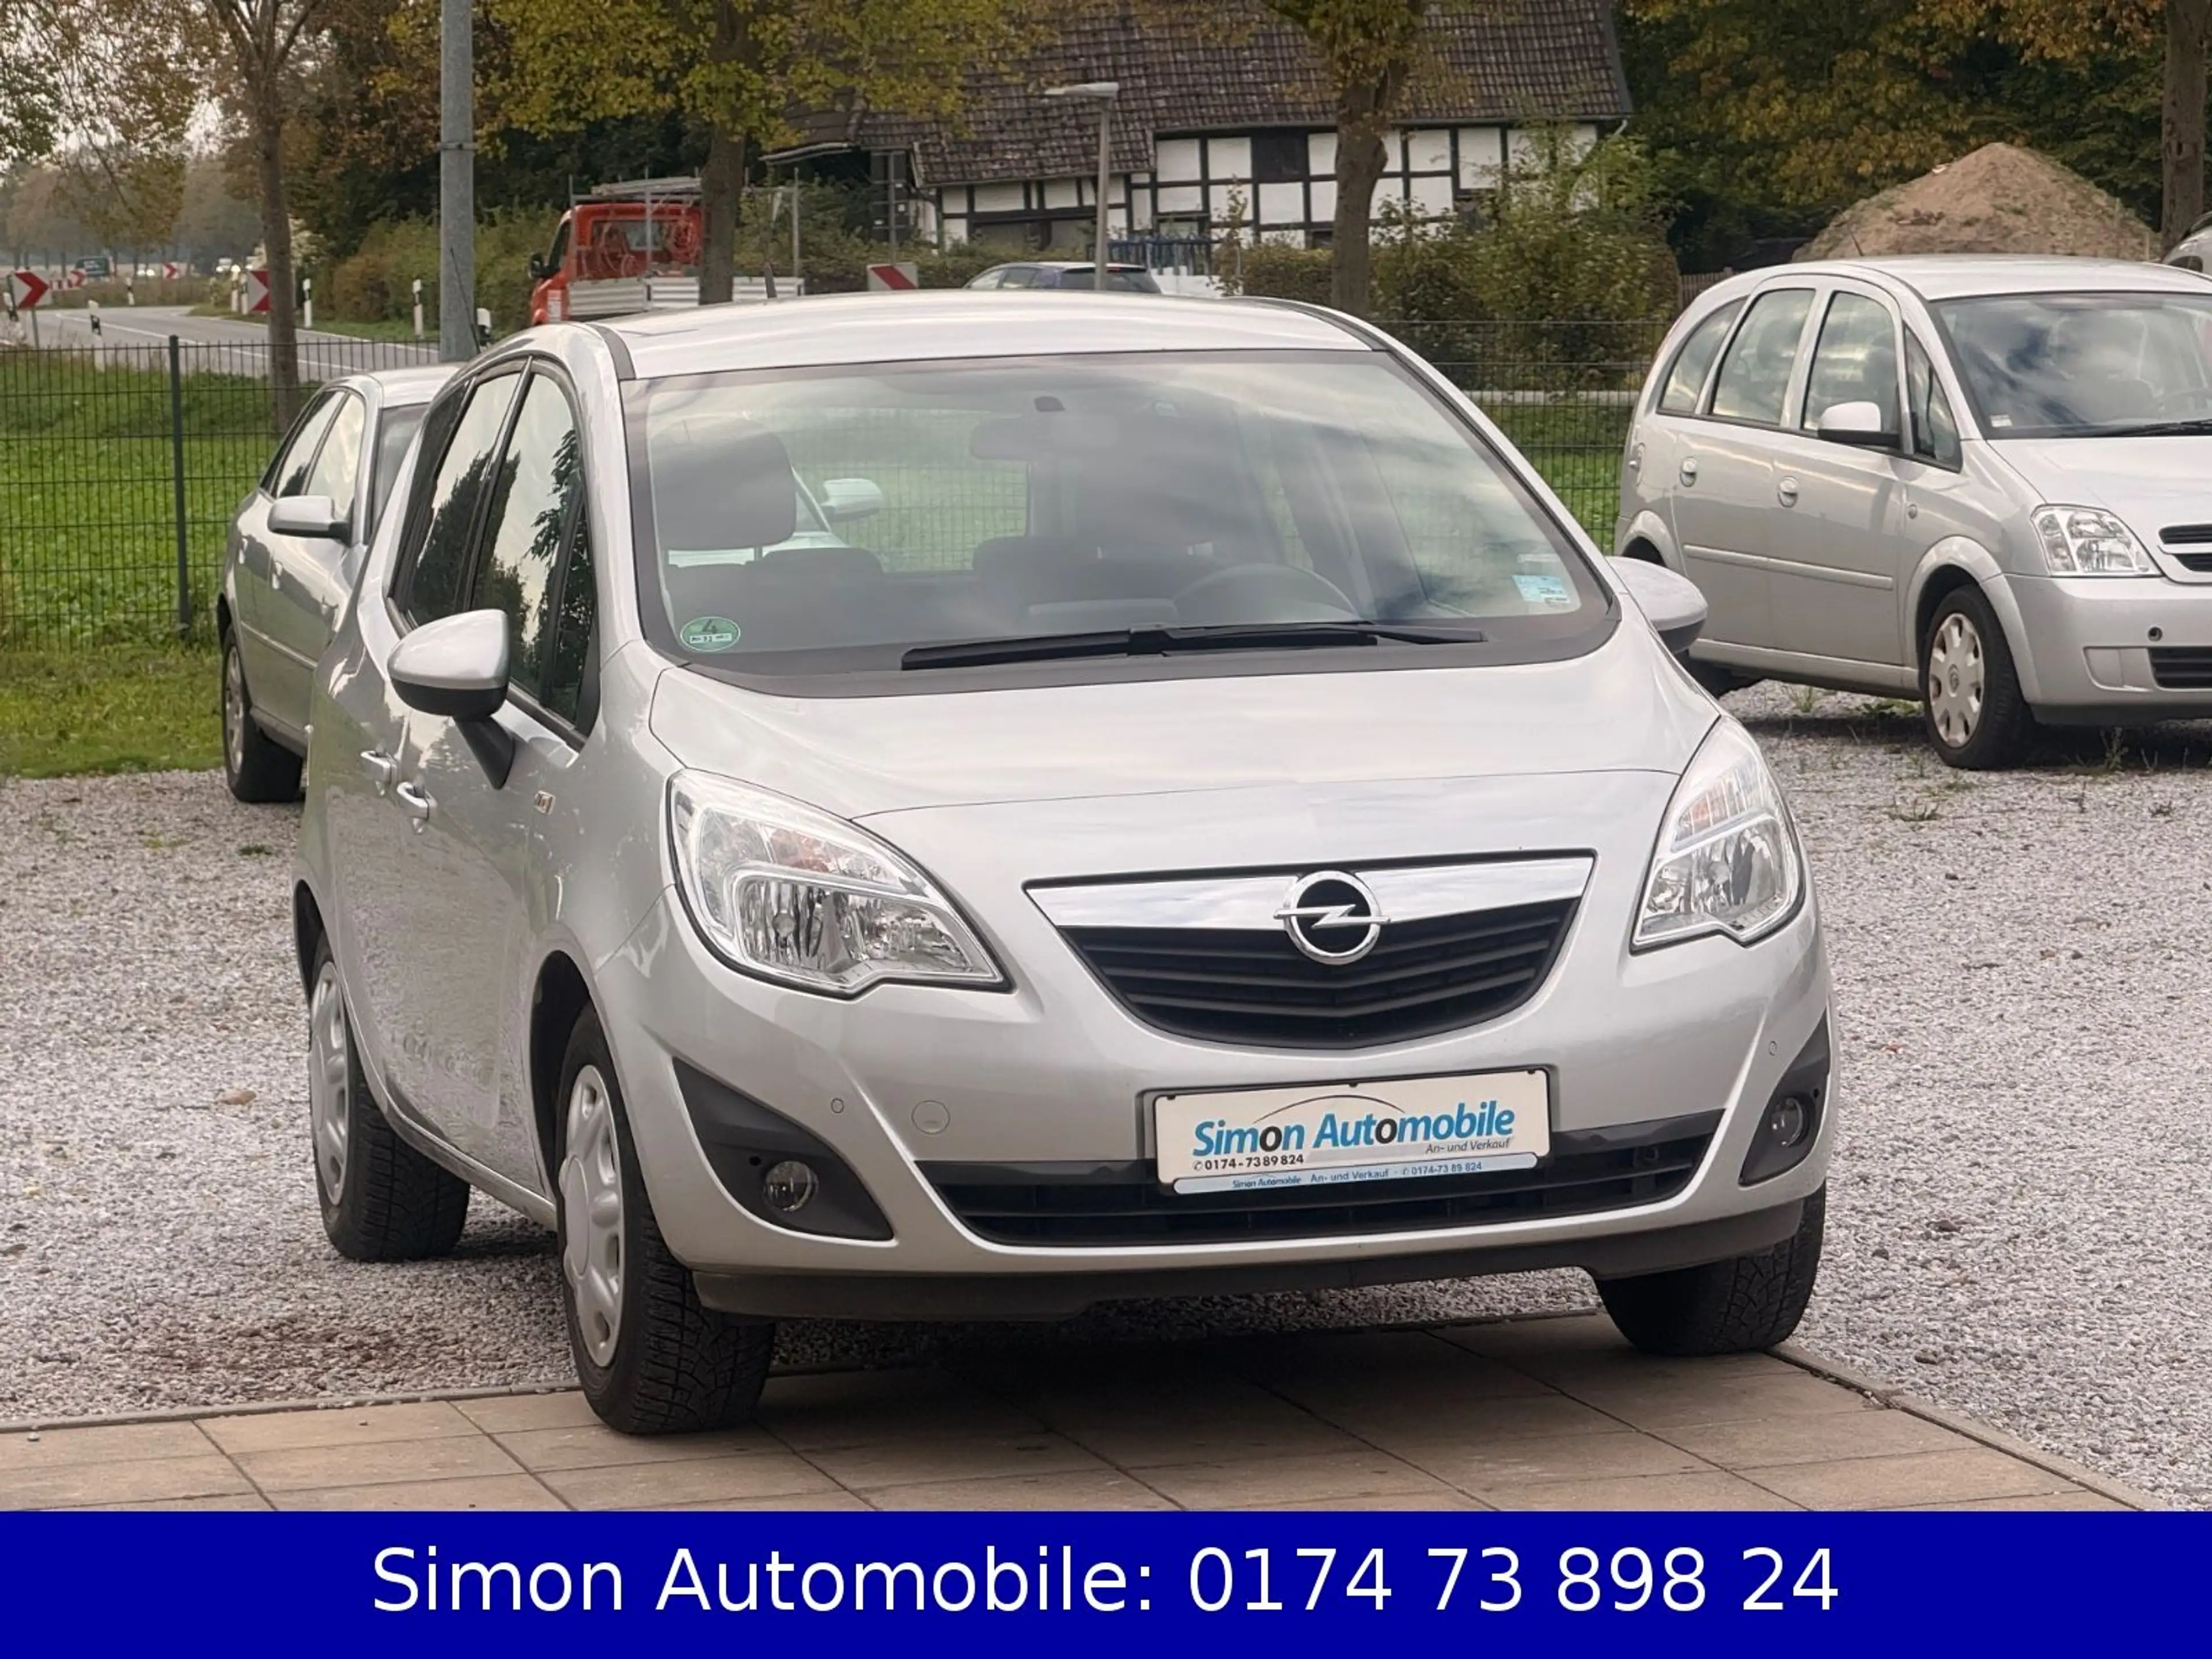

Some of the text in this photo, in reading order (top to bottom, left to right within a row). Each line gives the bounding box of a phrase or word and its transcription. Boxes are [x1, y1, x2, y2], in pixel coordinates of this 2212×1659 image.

[1192, 1100, 1515, 1156] Simon Automobile
[1447, 1141, 1467, 1152] und
[1470, 1138, 1512, 1151] Verkauf
[1232, 1179, 1256, 1188] Simon
[1257, 1176, 1301, 1187] Automobile
[1331, 1172, 1349, 1181] und
[1352, 1169, 1389, 1180] Verkauf
[1451, 1163, 1463, 1172] 89
[1465, 1161, 1482, 1171] 824
